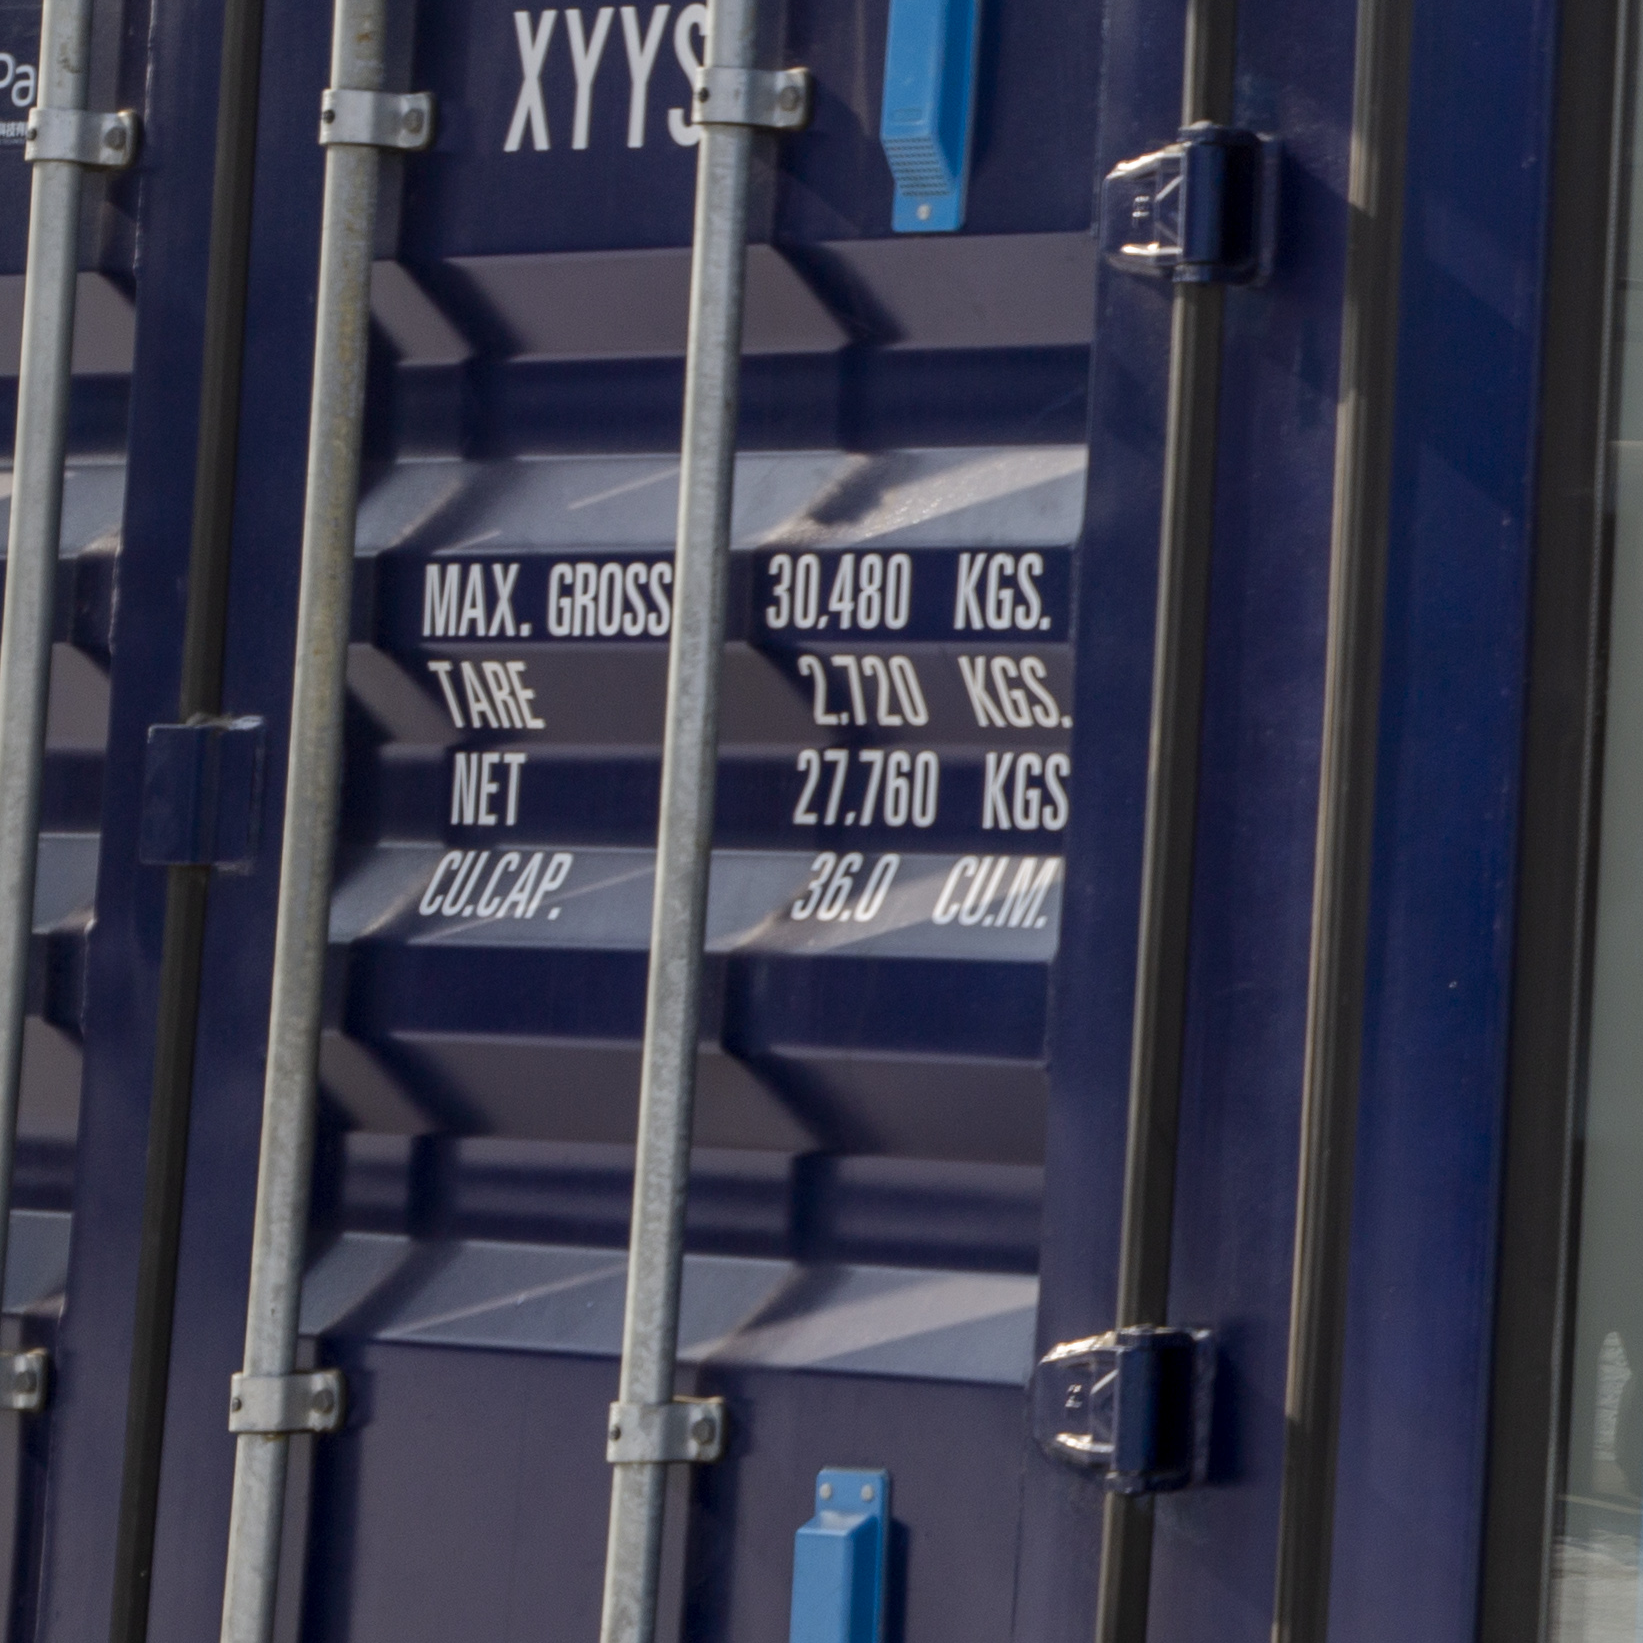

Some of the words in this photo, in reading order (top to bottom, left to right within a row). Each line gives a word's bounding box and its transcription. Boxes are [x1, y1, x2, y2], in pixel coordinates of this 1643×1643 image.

[422, 563, 532, 637] MAX.
[547, 562, 673, 637] GROSS
[953, 552, 1051, 630] KGS.
[427, 660, 546, 729] TARE
[957, 655, 1073, 729] KGS.
[450, 752, 527, 826] NET
[418, 850, 574, 920] CU.CAP.
[790, 851, 901, 923] 36.0
